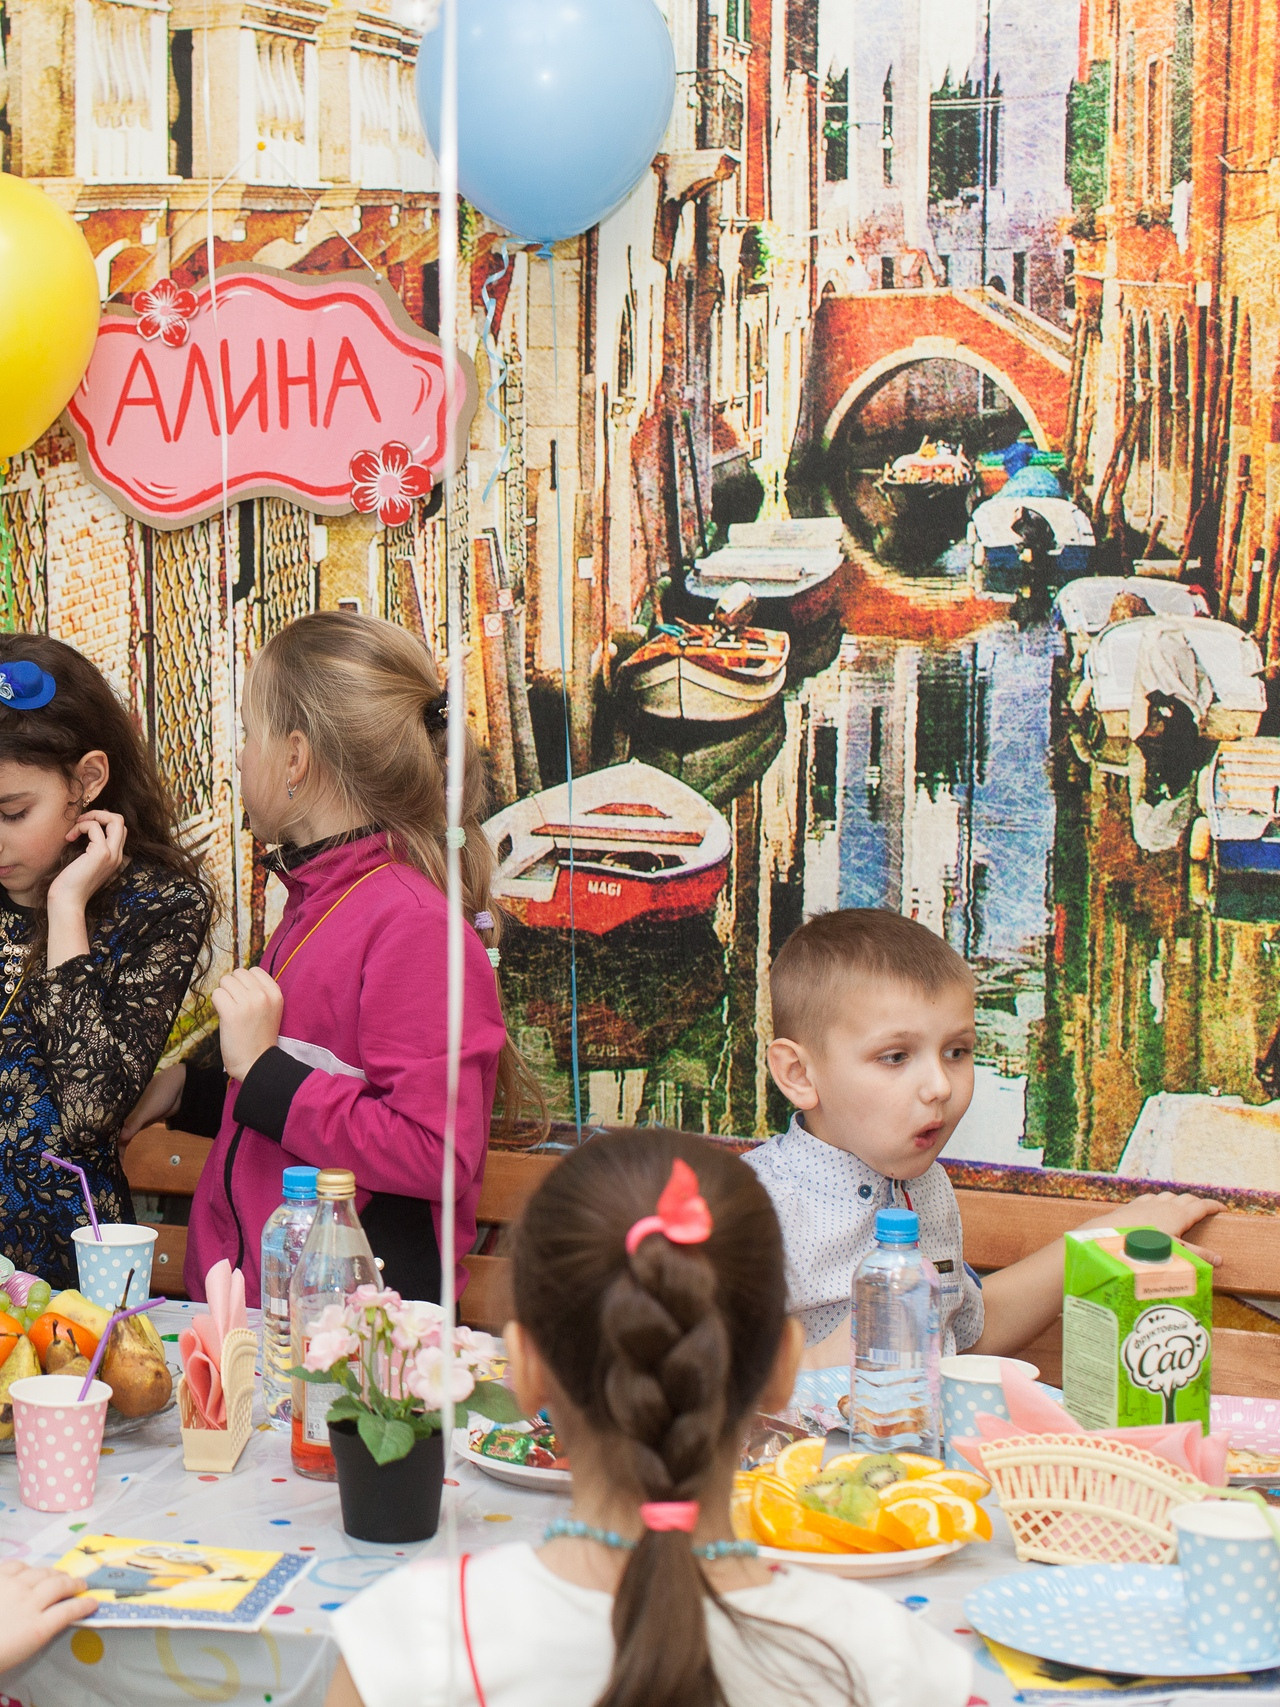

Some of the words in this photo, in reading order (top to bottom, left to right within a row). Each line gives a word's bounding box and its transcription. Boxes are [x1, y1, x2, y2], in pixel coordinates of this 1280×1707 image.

[106, 335, 382, 447] АЛИНА
[587, 879, 622, 897] MAGI
[1138, 1335, 1195, 1378] Сад
